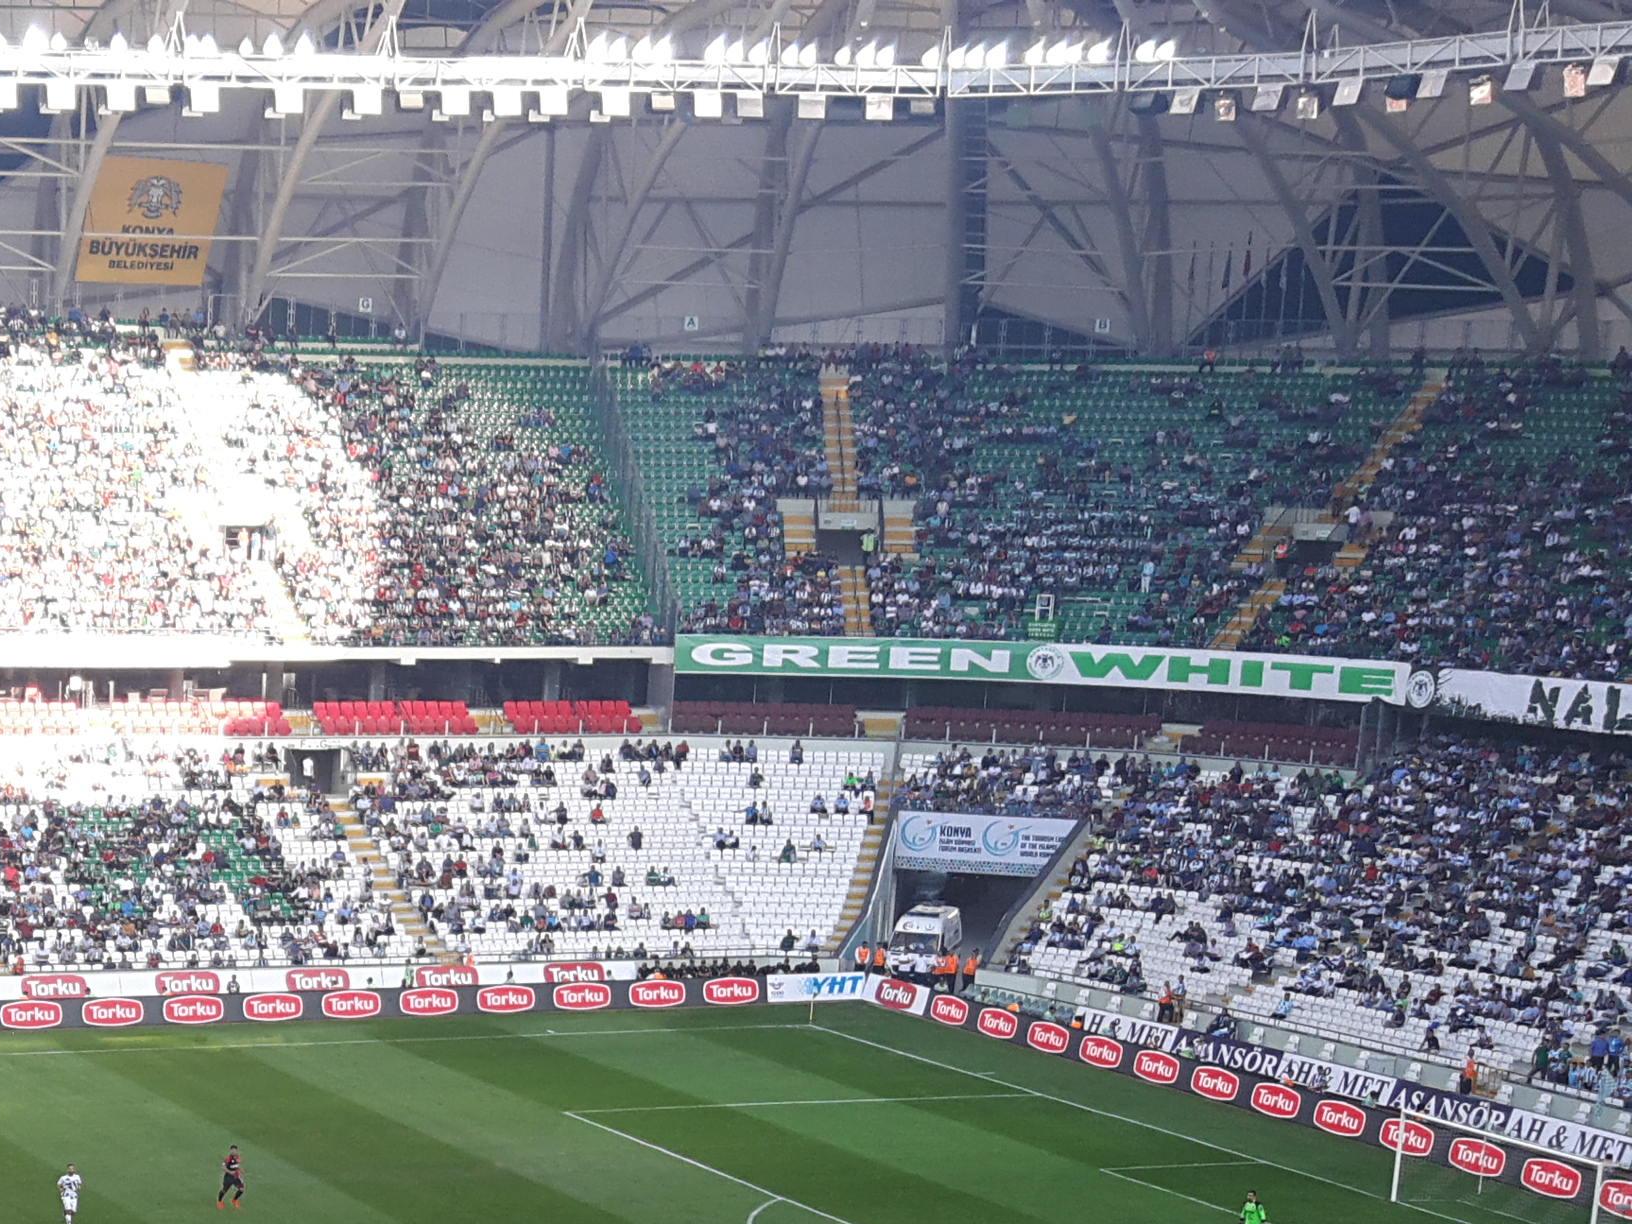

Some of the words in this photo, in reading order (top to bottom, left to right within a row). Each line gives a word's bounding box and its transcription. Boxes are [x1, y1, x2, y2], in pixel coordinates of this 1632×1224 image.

[88, 236, 200, 259] BÜYÜKŞEHİR
[108, 259, 175, 271] BELEDİYESİ
[686, 317, 696, 329] A
[690, 642, 1011, 673] GREEN
[1068, 650, 1396, 696] WHITE
[162, 975, 215, 994] Torku
[420, 969, 473, 987] Torku
[548, 966, 600, 984] Torku
[811, 974, 864, 994] YHT
[26, 978, 82, 997] Torku
[560, 988, 605, 1005] Torku
[636, 986, 680, 1002] Torku
[709, 983, 754, 999] Torku
[880, 982, 914, 1005] Torku
[170, 1001, 218, 1018] Torku
[250, 998, 297, 1016] Torku
[328, 996, 376, 1013] Torku
[407, 993, 453, 1010] Torku
[484, 991, 529, 1008] Torku
[7, 1006, 56, 1024] Torku
[89, 1003, 138, 1021] Torku
[936, 1000, 965, 1021] Torku
[983, 1013, 1013, 1034] Torku
[1033, 1027, 1065, 1048] Torku
[1126, 1020, 1174, 1049] MET
[1086, 1041, 1118, 1063] Torku
[1140, 1056, 1175, 1079] Torku
[1198, 1072, 1234, 1095] Torku
[1336, 1071, 1391, 1106] MET
[1258, 1088, 1295, 1113] Torku
[1321, 1106, 1360, 1131] Torku
[1505, 1113, 1548, 1143] AH
[1548, 1125, 1569, 1150] &
[1571, 1129, 1632, 1165] MET
[1457, 1143, 1499, 1171] Torku
[1530, 1164, 1574, 1192] Torku
